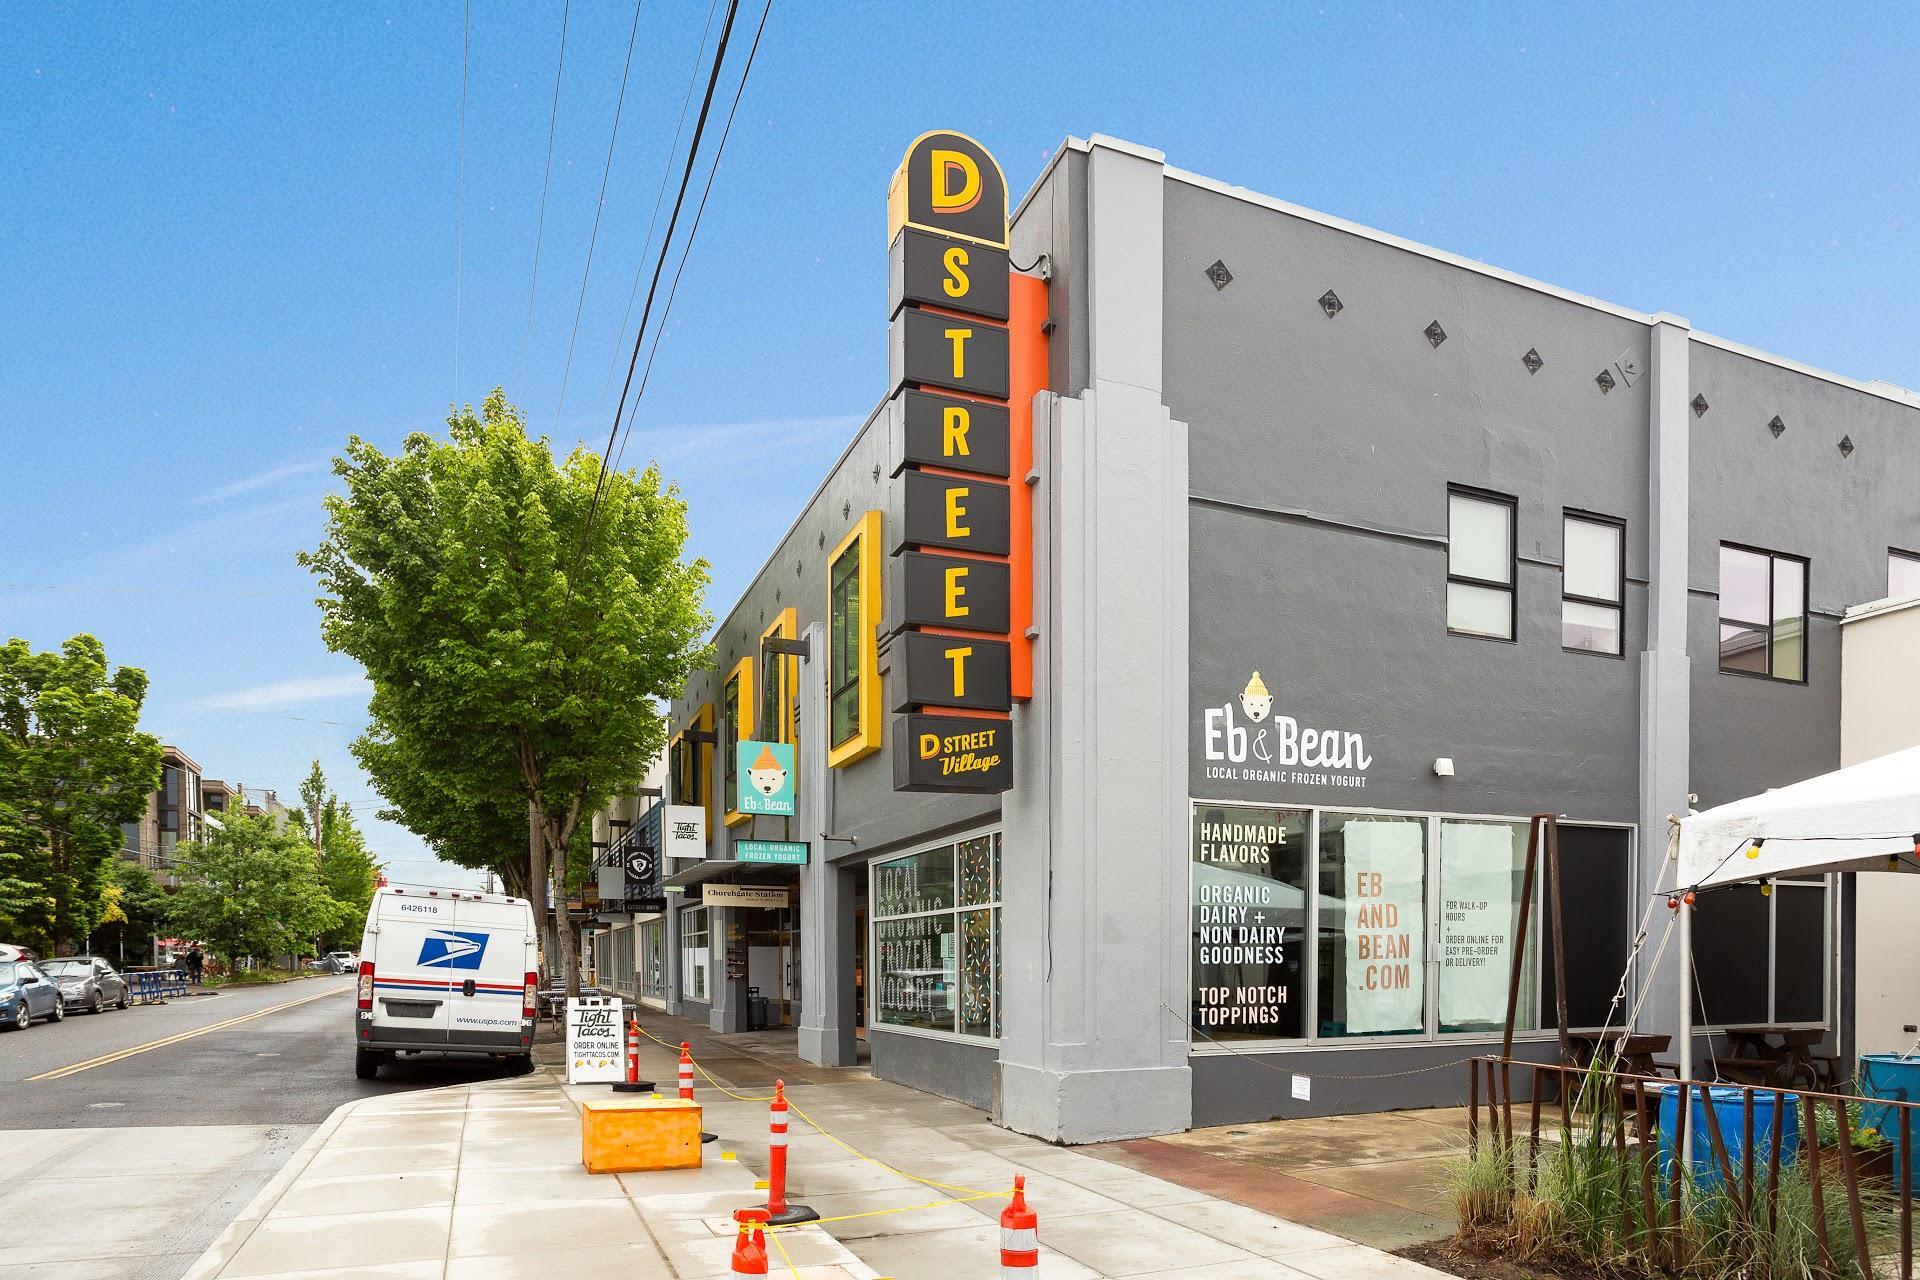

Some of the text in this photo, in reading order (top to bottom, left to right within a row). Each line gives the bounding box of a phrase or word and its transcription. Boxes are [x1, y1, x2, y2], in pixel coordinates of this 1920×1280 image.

[932, 149, 983, 698] D STREET
[920, 729, 996, 760] D STREET
[1204, 702, 1373, 771] Eb & Bean
[939, 752, 1001, 775] Village
[1206, 766, 1367, 788] LOCAL ORGANIC FROZEN YOGURT
[744, 795, 757, 810] Eb
[764, 798, 792, 811] Bean
[673, 822, 700, 834] Tight
[1200, 822, 1287, 844] HANDMADE
[744, 844, 800, 853] LOCAL ORGANIC
[745, 852, 801, 861] FROZEN YOGURT
[1200, 843, 1270, 864] FLAVORS
[878, 863, 921, 902] LOCAL
[1356, 872, 1383, 898] EB
[707, 889, 784, 899] Churchgate Station
[1200, 885, 1271, 904] ORGANIC
[401, 904, 438, 914] 6426118
[1200, 905, 1248, 924] DAIRY
[1357, 903, 1398, 928] AND
[1446, 900, 1488, 911] FOR WALK-UP
[879, 896, 943, 938] ORGANIC
[1446, 912, 1466, 922] HOURS
[1199, 926, 1286, 944] NON DAIRY
[1445, 935, 1504, 944] ORDER ONLINE FOR
[879, 938, 932, 974] FROZEN
[1199, 946, 1284, 965] GOODNESS
[1358, 933, 1411, 960] BEAN
[1445, 946, 1499, 956] EASY PRE-ORDER
[1445, 957, 1486, 967] OR DELIVERY!
[1359, 964, 1411, 991] .COM
[880, 976, 934, 1014] YOGURT
[1199, 986, 1287, 1006] TOP NOTCH
[456, 1017, 518, 1027] www.usps.com
[573, 1008, 618, 1028] Tight
[1199, 1006, 1279, 1026] TOPPINGS
[573, 1041, 619, 1050] ORDER ONLINE
